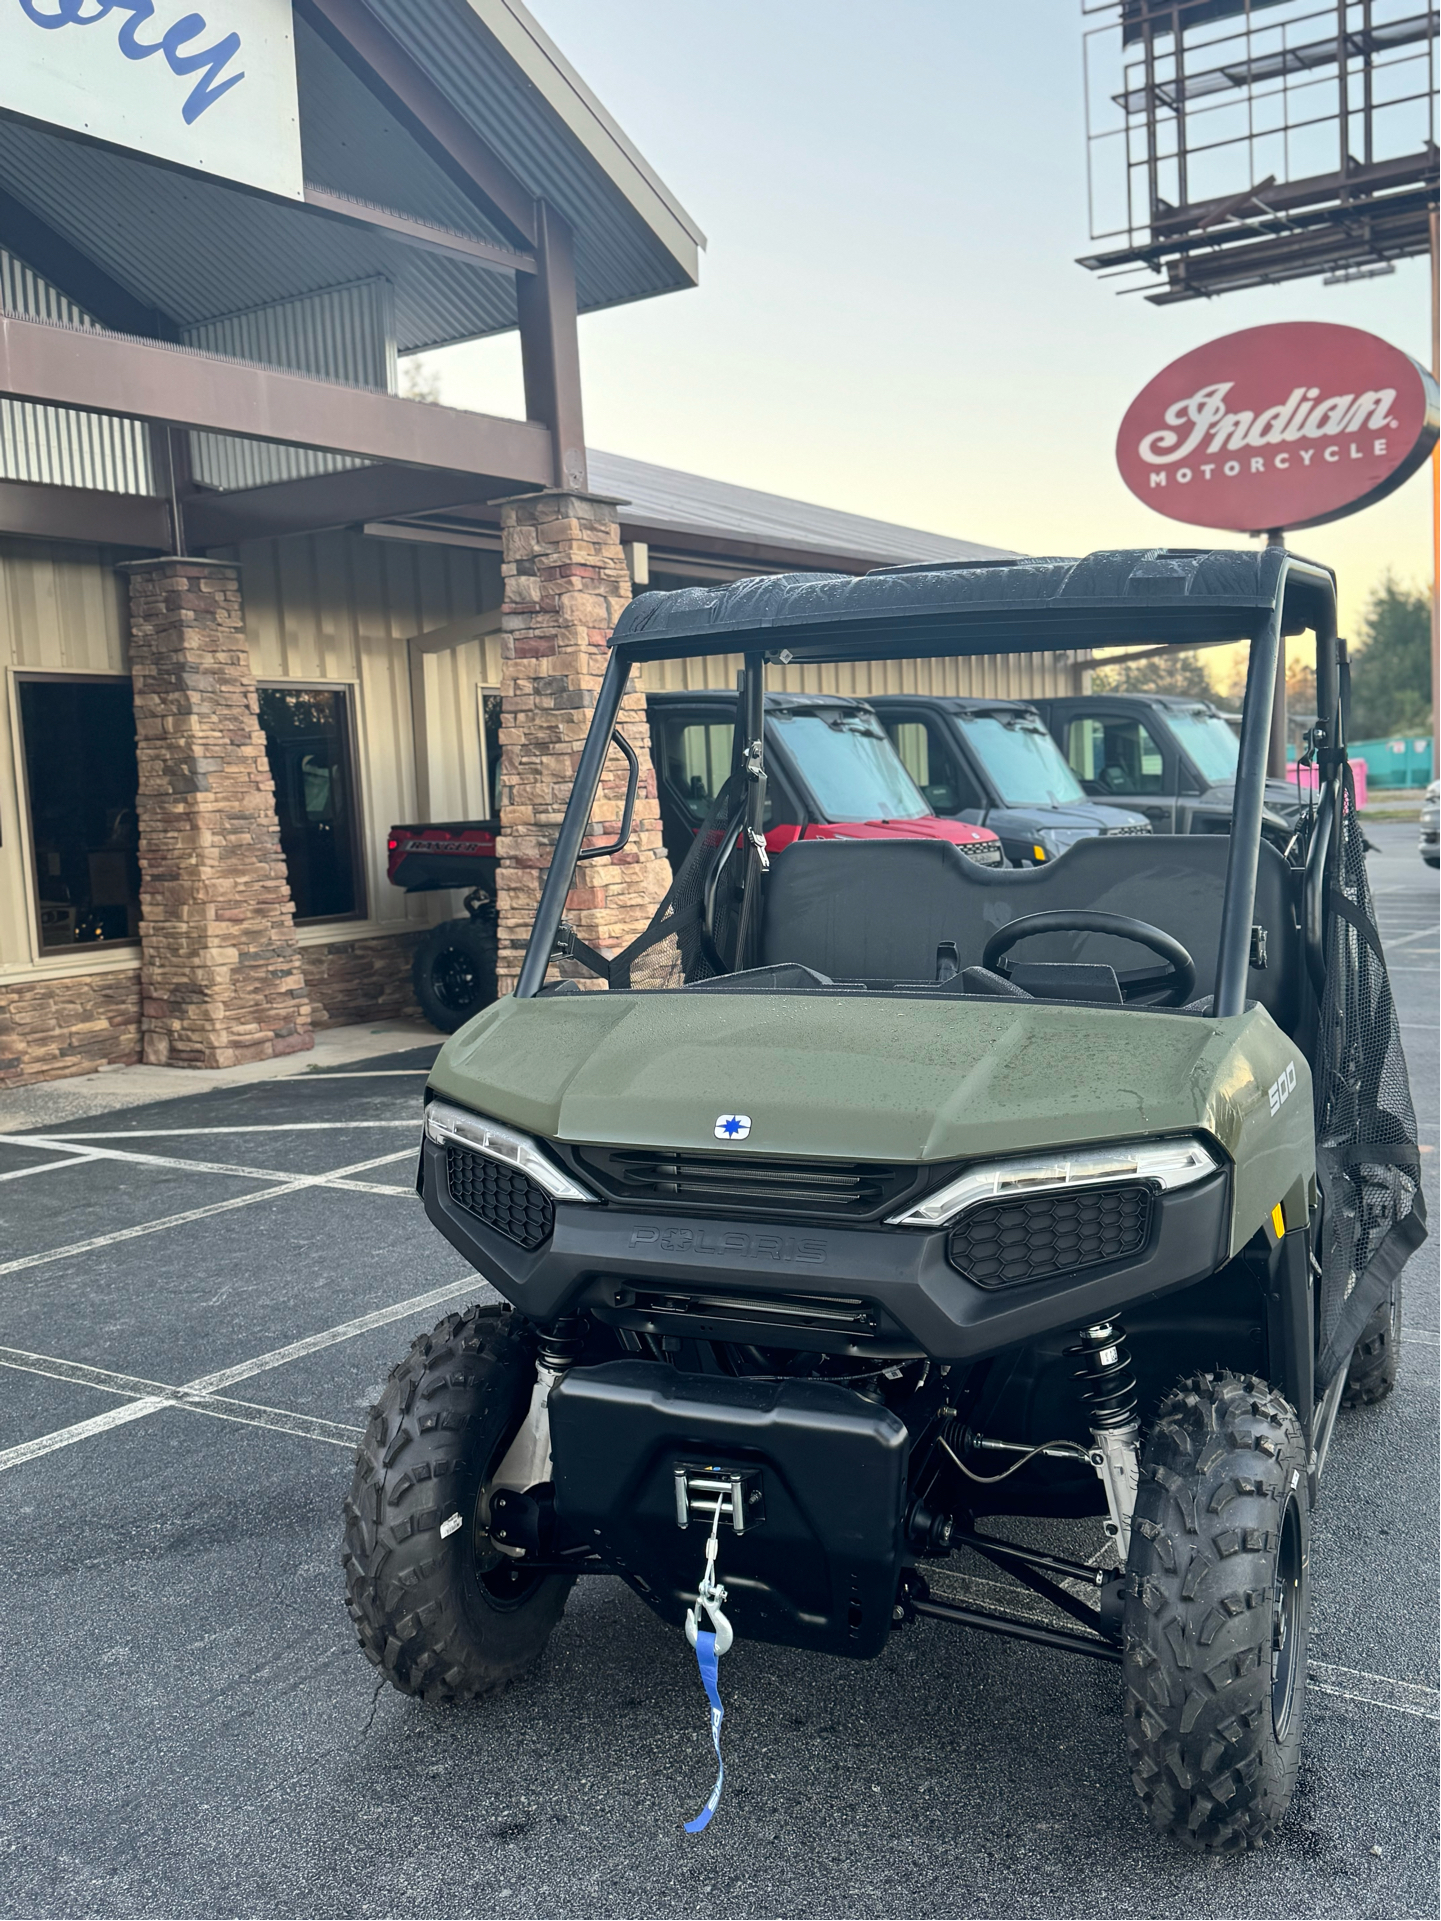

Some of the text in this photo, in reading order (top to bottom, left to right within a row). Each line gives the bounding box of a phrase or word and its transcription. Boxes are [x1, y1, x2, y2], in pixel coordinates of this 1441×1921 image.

[1138, 382, 1398, 465] Indian
[1150, 439, 1388, 488] MOTORCYCLE
[409, 841, 479, 852] RANGER
[1268, 1060, 1297, 1117] 500
